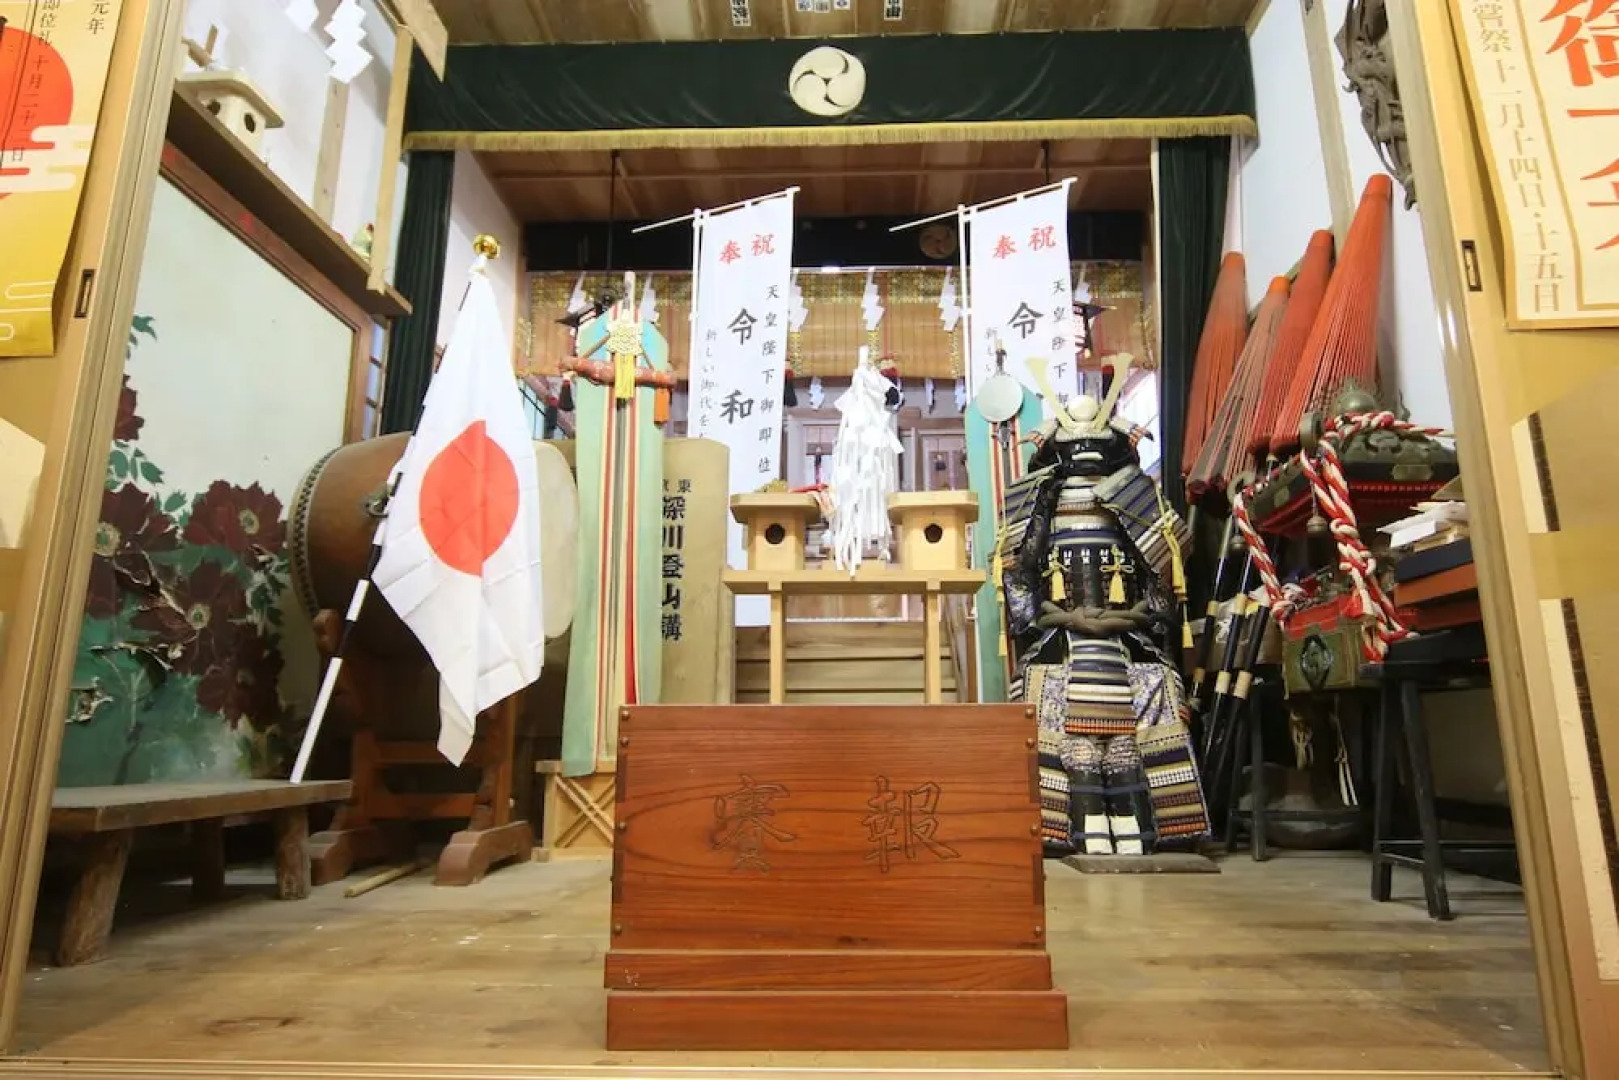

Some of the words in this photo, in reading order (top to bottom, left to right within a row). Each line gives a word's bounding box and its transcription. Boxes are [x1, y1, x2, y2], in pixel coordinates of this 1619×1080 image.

[718, 233, 776, 264] 奉祝
[993, 226, 1057, 260] 奉祝
[1008, 302, 1044, 339] 令
[720, 307, 758, 425] 令和
[758, 285, 780, 473] 天皇陛下御即位
[662, 496, 686, 642] 深川登山講
